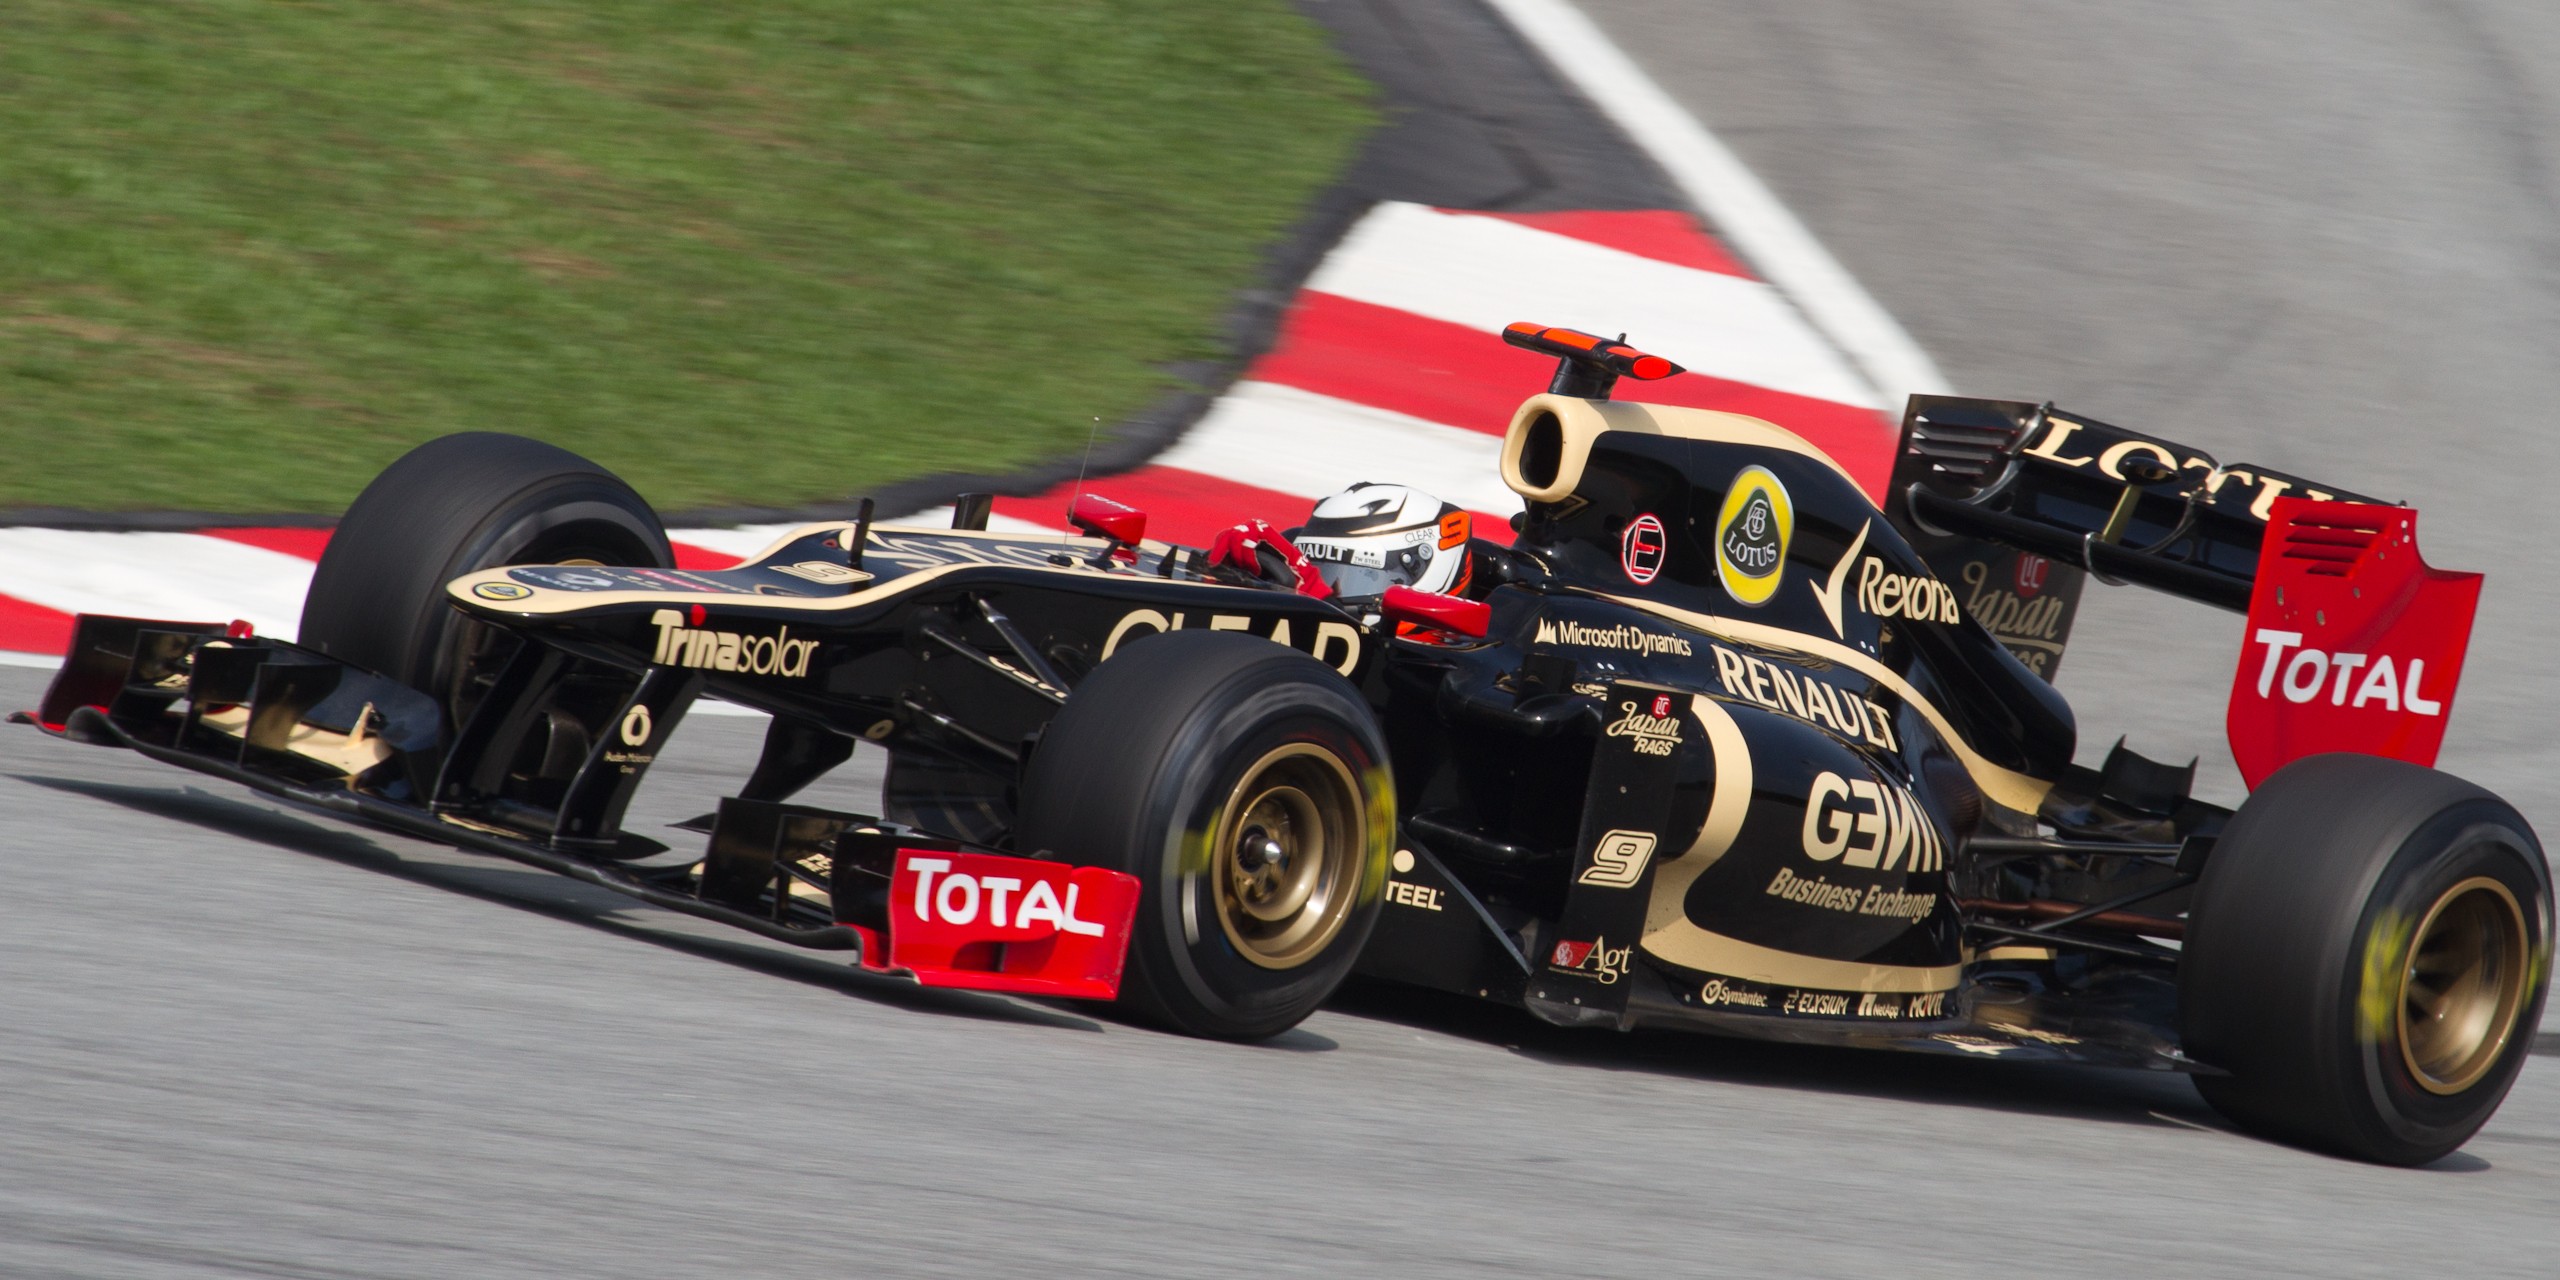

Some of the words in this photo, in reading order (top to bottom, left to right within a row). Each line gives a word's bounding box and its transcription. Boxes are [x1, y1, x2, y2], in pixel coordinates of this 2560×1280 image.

[2024, 416, 2366, 521] LOTU
[1294, 543, 1348, 562] NAULT
[1404, 528, 1436, 544] CLEAR
[1438, 510, 1471, 551] 9
[1726, 530, 1777, 567] LOTUS
[1859, 556, 1960, 624] Rexona
[651, 604, 819, 678] Trinasolar
[1559, 620, 1630, 650] Microsoft
[1631, 625, 1692, 657] Dynamics
[2255, 628, 2441, 716] TOTAL
[1606, 701, 1681, 743] Japan
[1711, 644, 1899, 754] RENAULT
[1633, 738, 1674, 757] RAGS
[1578, 829, 1657, 889] 9
[907, 857, 1105, 938] TOTAL
[1386, 880, 1443, 912] TEEL
[1766, 866, 1862, 912] Business
[1859, 884, 1936, 924] Exchange
[1576, 934, 1634, 984] Agt
[1798, 993, 1850, 1015] ELYSIUM
[1873, 1004, 1899, 1019] NetApp
